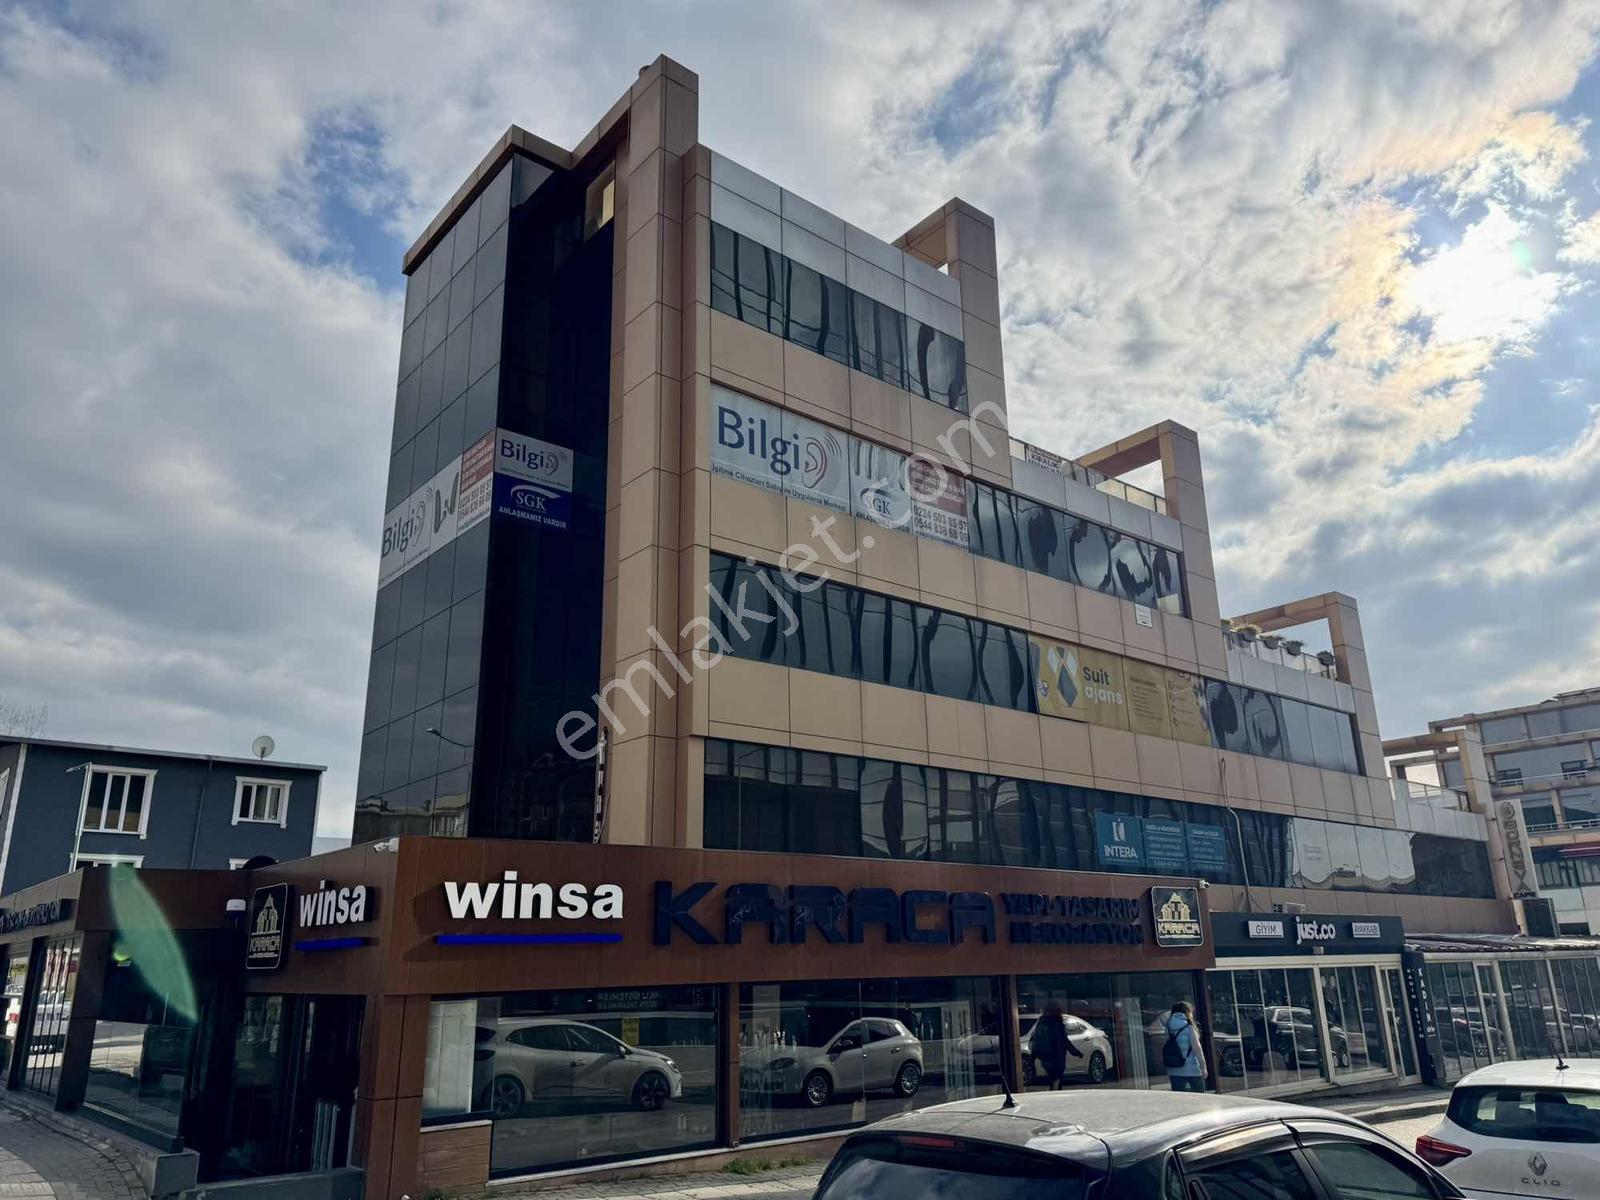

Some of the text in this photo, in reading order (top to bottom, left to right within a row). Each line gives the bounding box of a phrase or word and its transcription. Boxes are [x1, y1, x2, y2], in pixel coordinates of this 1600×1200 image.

[718, 406, 800, 475] Bilgi
[501, 439, 543, 470] Bilgi
[515, 491, 546, 511] SGK
[864, 494, 892, 515] SGK
[382, 508, 414, 558] Bilgi
[1085, 686, 1122, 705] ajans
[300, 879, 366, 927] winsa
[444, 870, 624, 919] winsa
[654, 881, 996, 945] KARACA
[1158, 923, 1200, 934] KARACA
[1255, 922, 1277, 934] GİYİM
[1296, 916, 1335, 944] just.co
[250, 935, 281, 952] KARACA
[1521, 1177, 1561, 1187] CLIO
